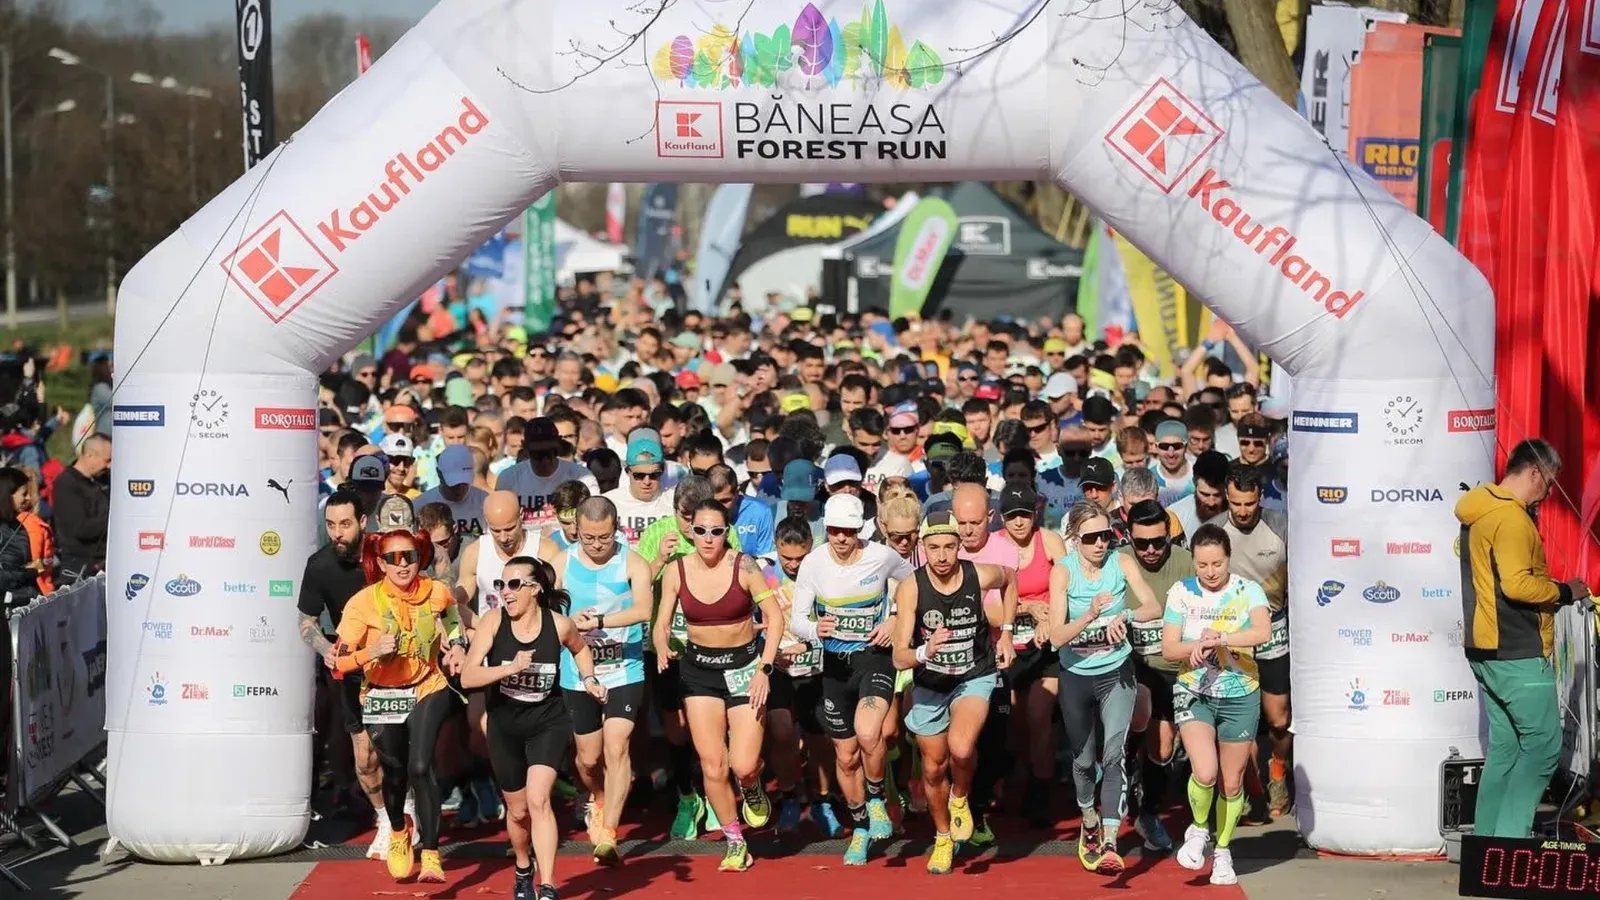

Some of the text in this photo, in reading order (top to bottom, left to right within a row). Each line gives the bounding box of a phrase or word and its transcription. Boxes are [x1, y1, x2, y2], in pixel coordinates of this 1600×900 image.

[735, 94, 945, 135] BĂNEASA
[664, 141, 716, 151] Kaufland
[738, 140, 947, 159] FOREST RUN
[1364, 144, 1419, 165] RIO
[318, 97, 489, 252] Kaufland
[1187, 169, 1364, 319] Kaufland
[1384, 396, 1412, 414] GOOD
[261, 413, 314, 428] BOROTALCO
[1294, 416, 1353, 428] HEINNER
[130, 482, 152, 491] RIO
[176, 483, 249, 496] DORNA
[1319, 489, 1345, 498] RIO
[1371, 489, 1443, 502] DORNA
[189, 535, 235, 548] World Class
[1387, 542, 1432, 554] World Class
[168, 581, 198, 593] Scotti
[1366, 588, 1397, 600] Scotti
[950, 607, 971, 617] HBO
[142, 621, 172, 631] POWER
[945, 614, 978, 627] Medical
[190, 626, 229, 636] Dr.Max
[1338, 628, 1372, 638] POWER
[1391, 633, 1429, 643] Dr.Max
[509, 674, 545, 688] 3115
[246, 686, 279, 696] FEPRA
[1446, 690, 1474, 701] FEPRA
[372, 700, 408, 711] 3465
